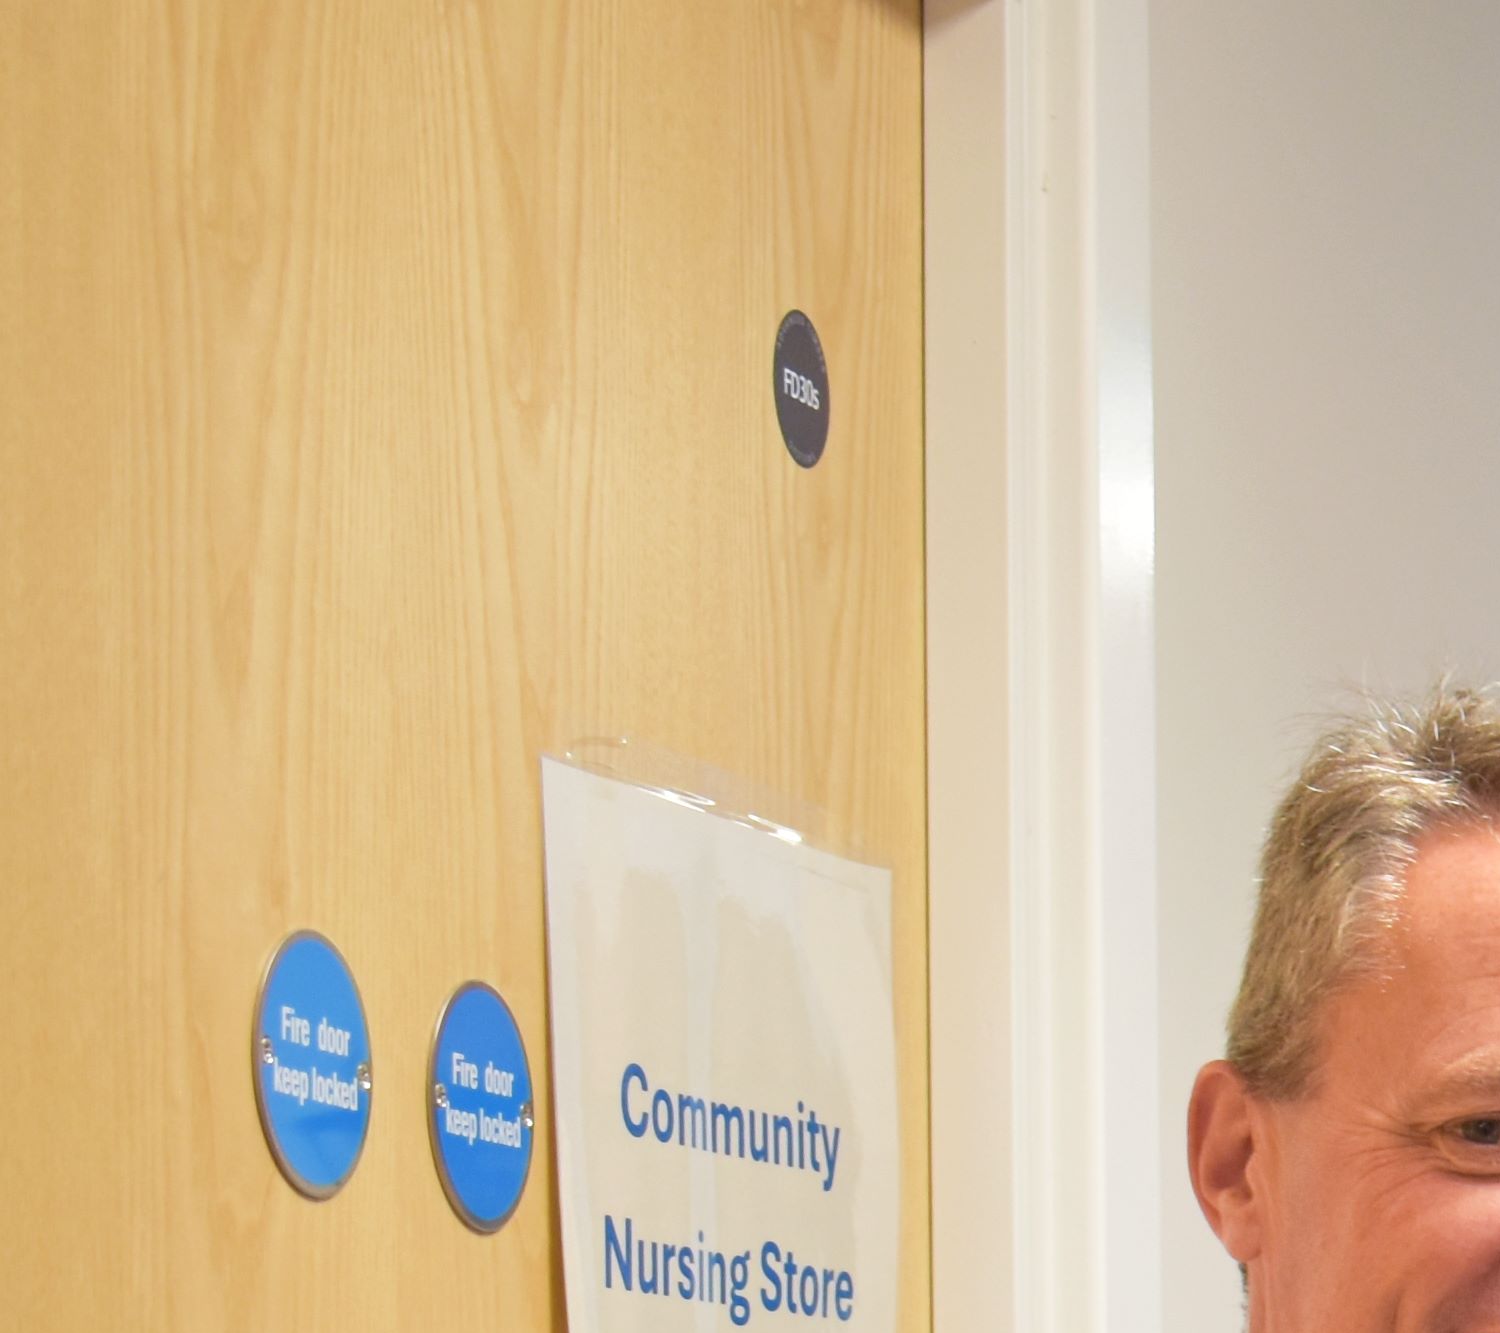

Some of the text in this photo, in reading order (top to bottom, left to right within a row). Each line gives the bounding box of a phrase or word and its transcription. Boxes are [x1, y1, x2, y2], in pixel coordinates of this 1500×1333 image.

[784, 368, 819, 410] FD30s
[281, 1006, 350, 1057] Fire door
[273, 1057, 358, 1111] keep locked
[452, 1052, 515, 1098] Fire door
[446, 1101, 522, 1148] keep locked
[620, 1062, 841, 1192] Community
[604, 1214, 854, 1326] Nursing Store
